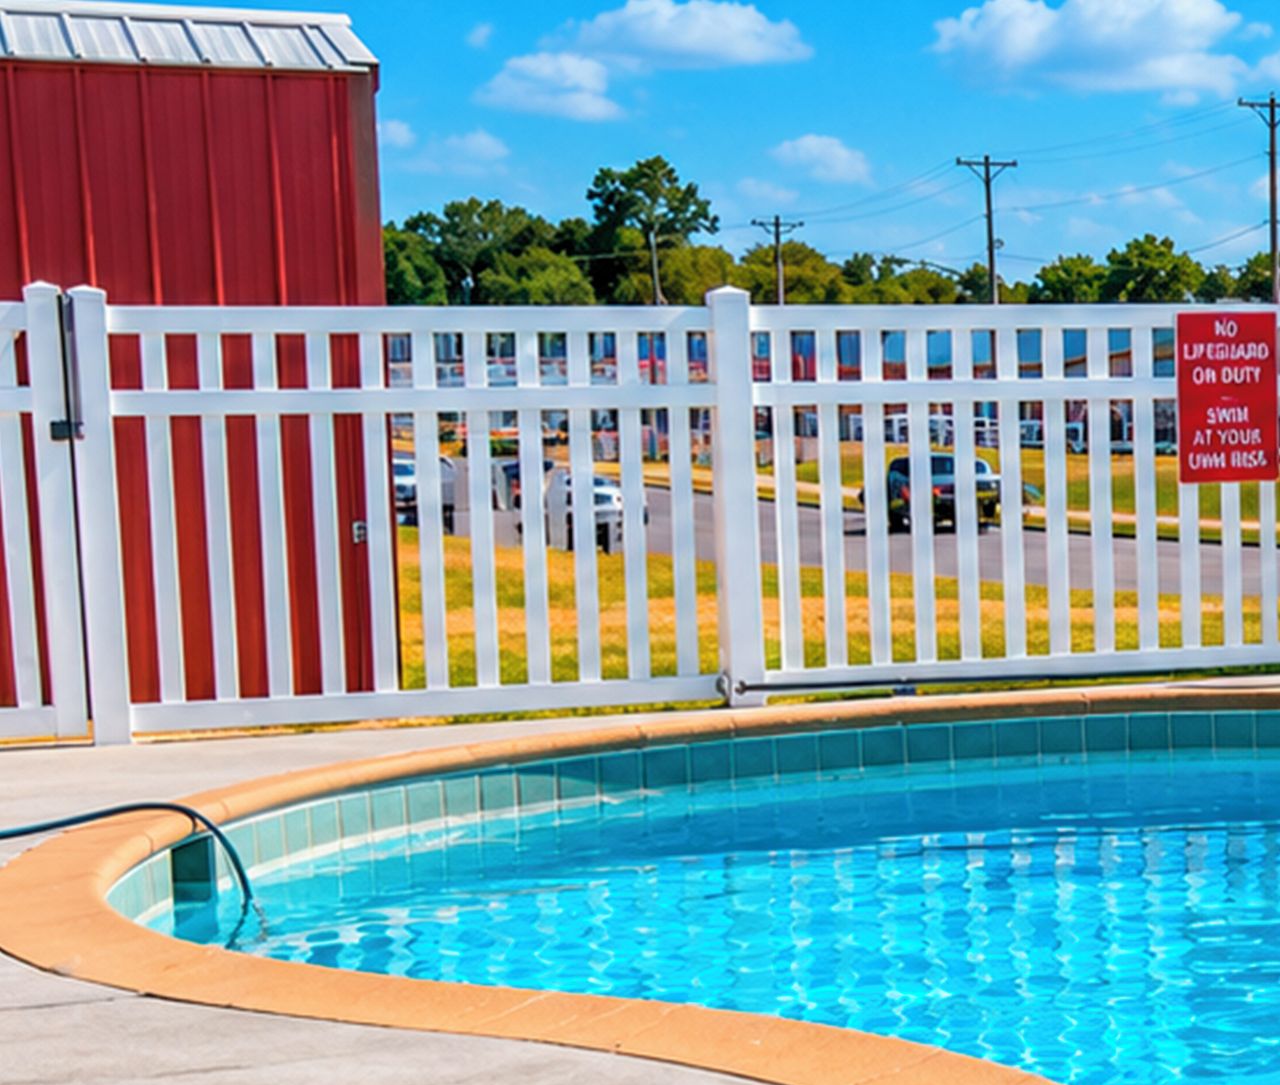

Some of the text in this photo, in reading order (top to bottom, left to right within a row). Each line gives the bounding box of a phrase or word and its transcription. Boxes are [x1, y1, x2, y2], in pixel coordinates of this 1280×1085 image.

[1214, 320, 1238, 337] NO
[1221, 367, 1261, 384] DUTY
[1207, 407, 1248, 424] SWIM
[1193, 429, 1261, 446] AT YOUR
